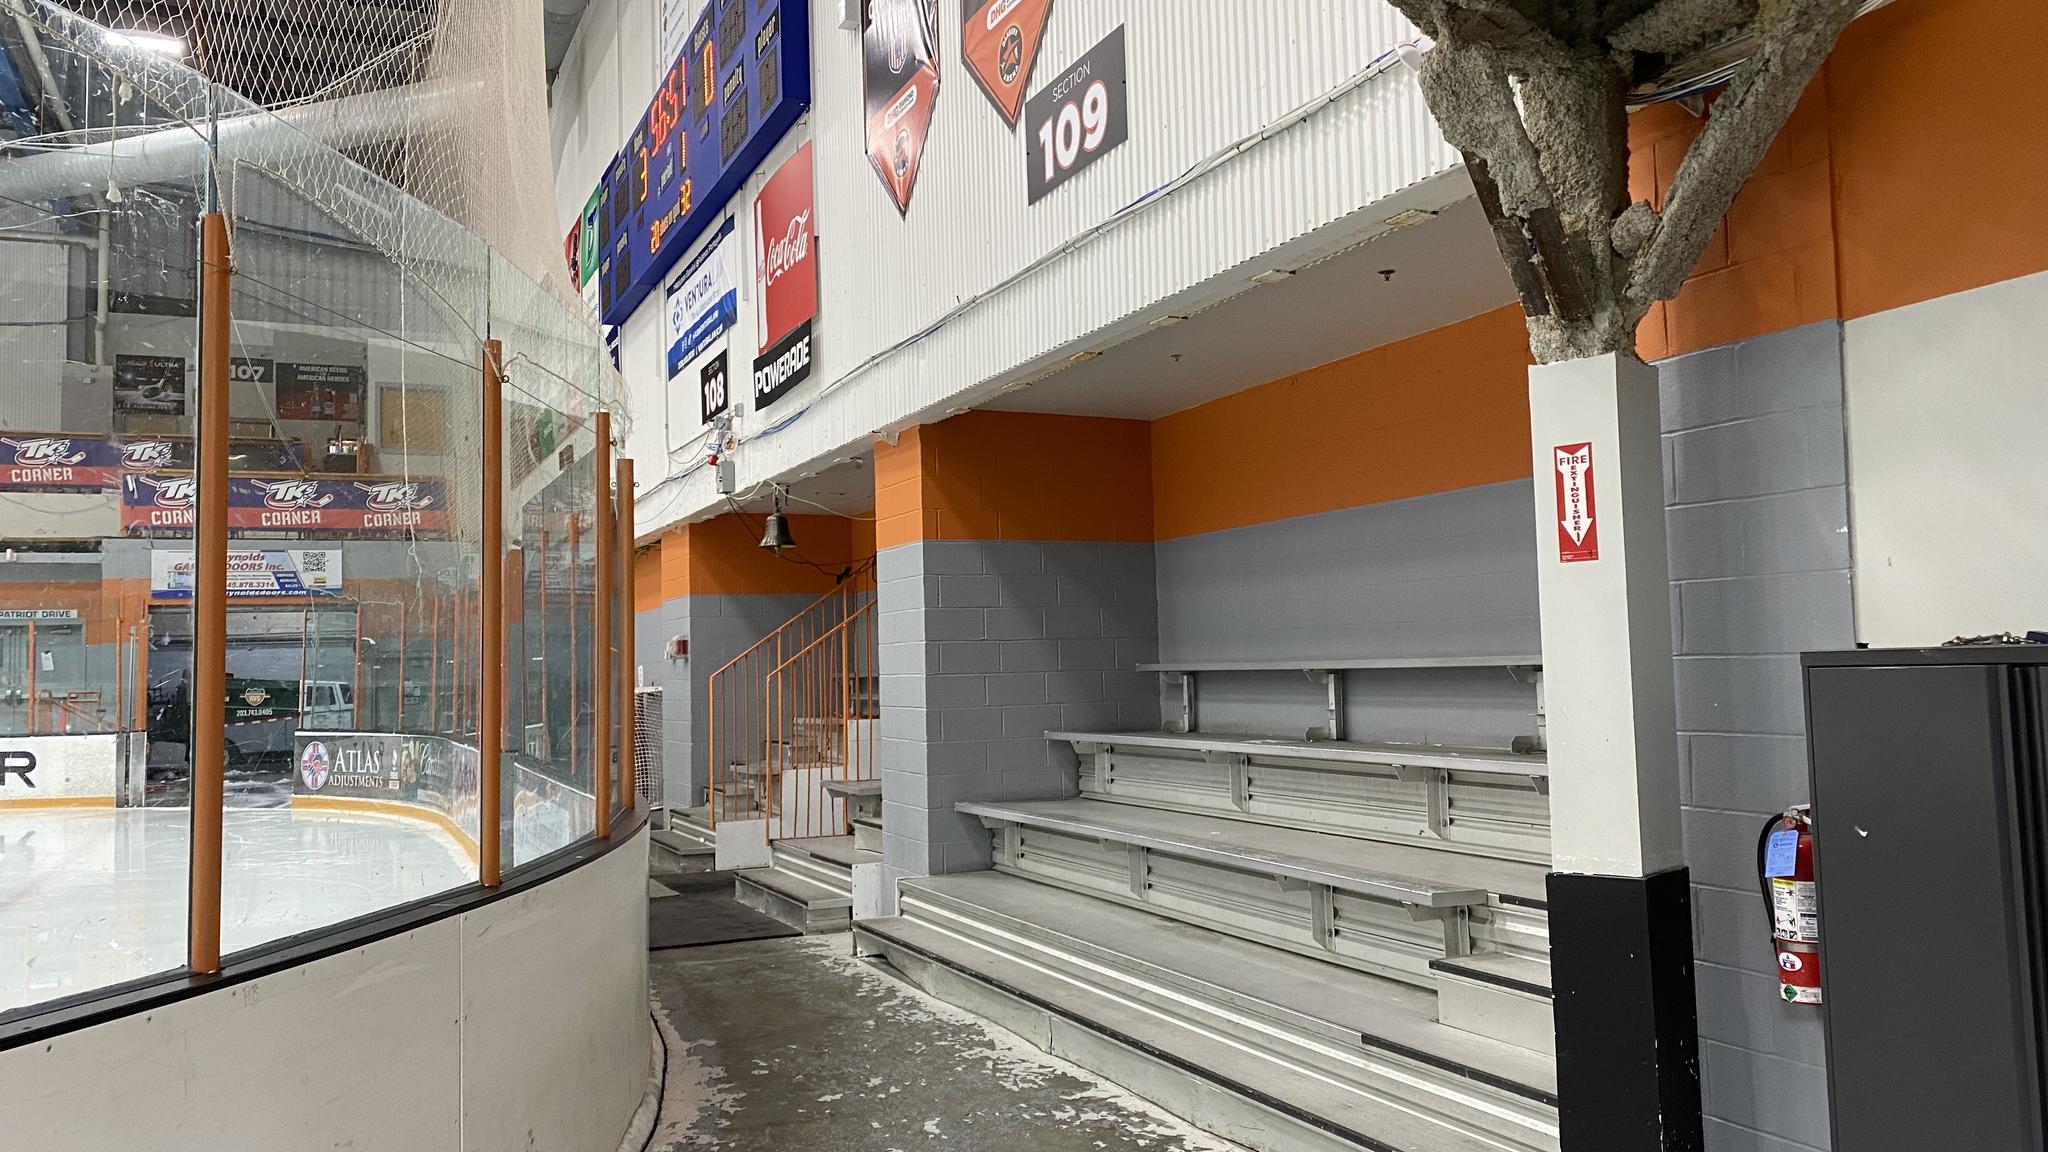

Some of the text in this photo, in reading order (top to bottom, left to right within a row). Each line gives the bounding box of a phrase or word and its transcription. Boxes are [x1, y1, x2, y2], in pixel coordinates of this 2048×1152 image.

[758, 15, 776, 58] player
[1052, 61, 1091, 103] SECTION
[1038, 80, 1107, 183] 109
[154, 361, 179, 369] ULTRA
[230, 365, 265, 380] 107
[755, 335, 811, 398] POWERADE
[704, 372, 725, 416] 108
[1559, 454, 1588, 467] FIRE
[11, 467, 74, 483] CORNER
[1570, 465, 1582, 532] EXTINGUISHER
[151, 510, 194, 525] CORN
[262, 510, 321, 526] CORNER
[364, 512, 421, 528] CORNER
[227, 552, 265, 562] ynolds
[265, 562, 285, 571] Inc.
[227, 589, 307, 597] ynoldsdoors.com
[41, 610, 71, 618] DRIVE
[333, 747, 380, 773] ATLAS
[328, 774, 383, 788] ADJUSTMENTS
